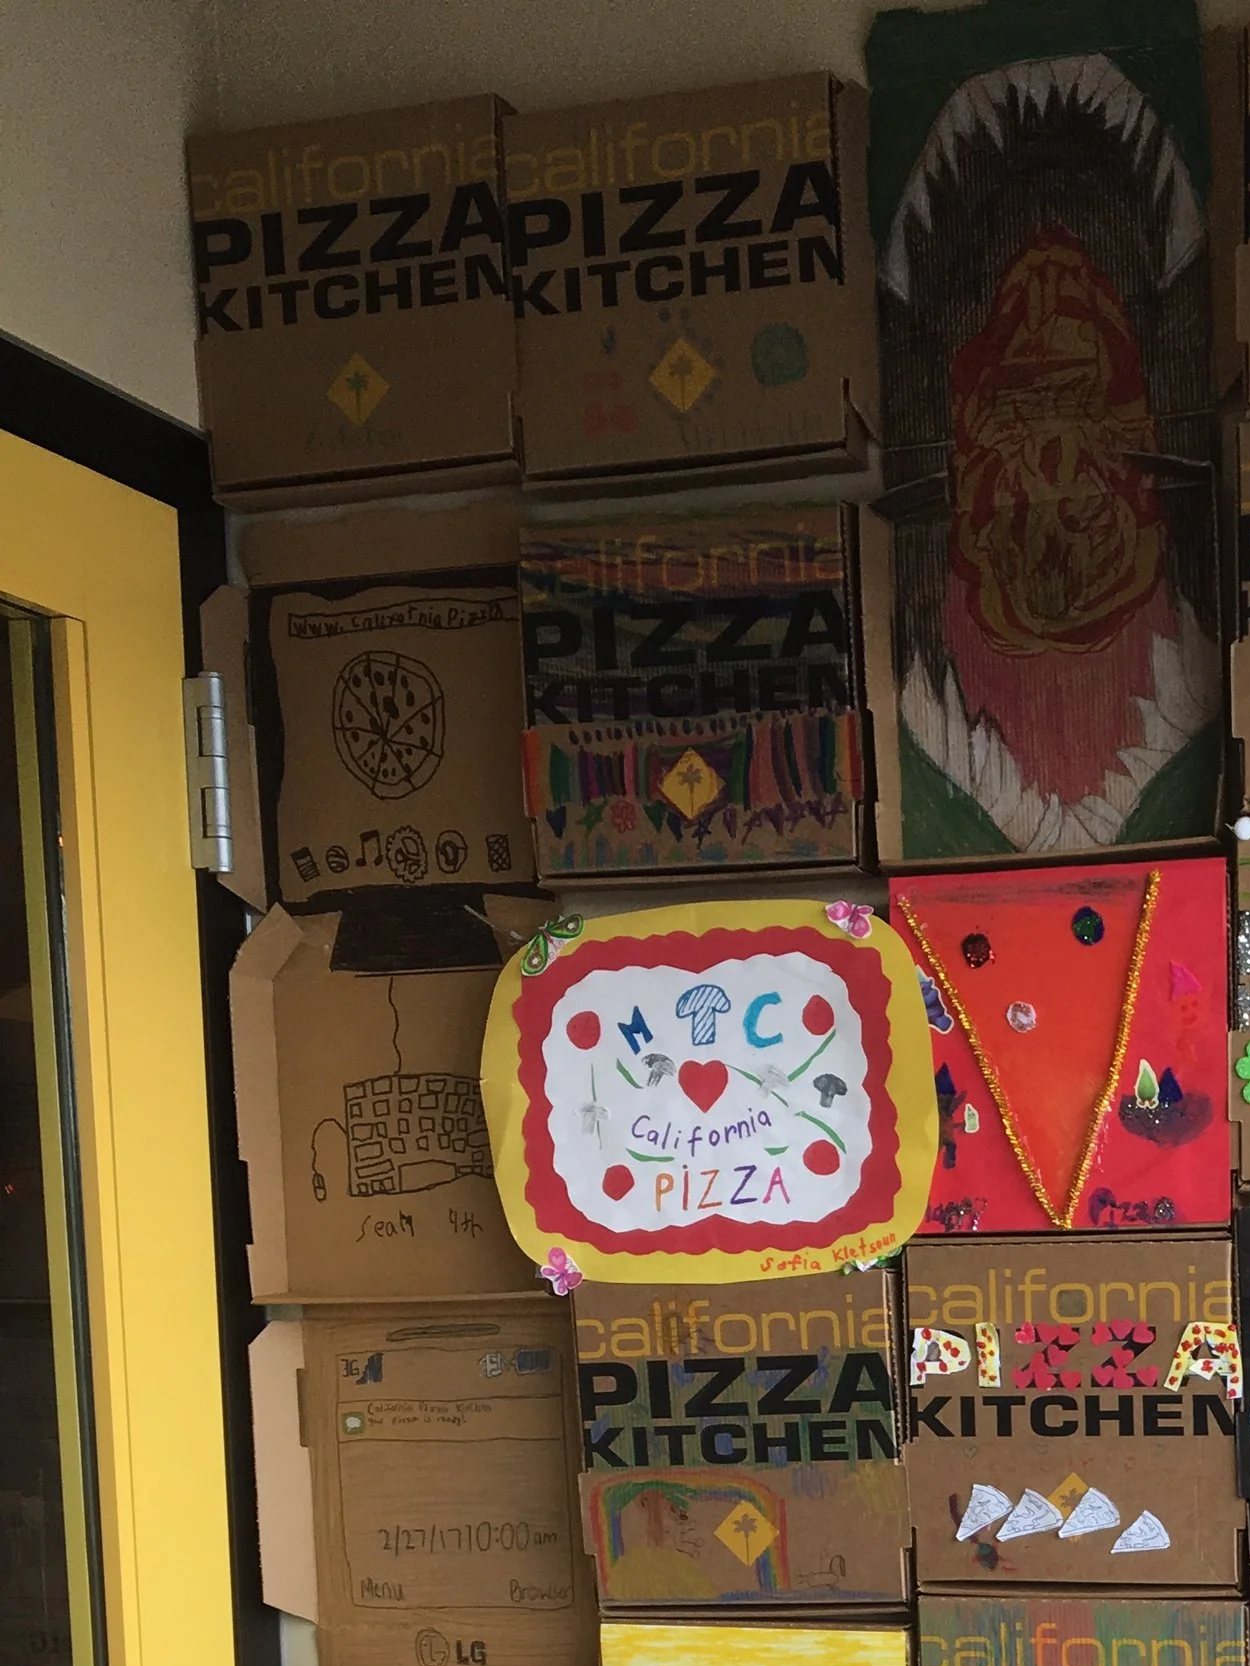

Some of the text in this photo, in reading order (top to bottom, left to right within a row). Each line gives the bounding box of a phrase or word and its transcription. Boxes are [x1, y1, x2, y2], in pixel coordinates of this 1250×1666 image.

[191, 124, 501, 215] california
[504, 104, 831, 198] california
[193, 181, 502, 283] PIZZA
[506, 160, 840, 267] PIZZA
[199, 254, 507, 334] KITCHEN
[512, 235, 844, 319] KITCHEN
[526, 589, 846, 674] PIZZA
[526, 663, 851, 725] KITCHEN
[630, 1107, 773, 1155] California
[653, 1164, 792, 1213] PIZZA
[760, 1252, 822, 1272] Sofia
[578, 1293, 891, 1358] california
[909, 1265, 1232, 1328] california
[579, 1351, 892, 1420] PIZZA
[908, 1319, 1243, 1399] PIZZA
[583, 1418, 898, 1470] KITCHEN
[910, 1395, 1240, 1438] KITCHEN
[455, 1639, 488, 1666] LG
